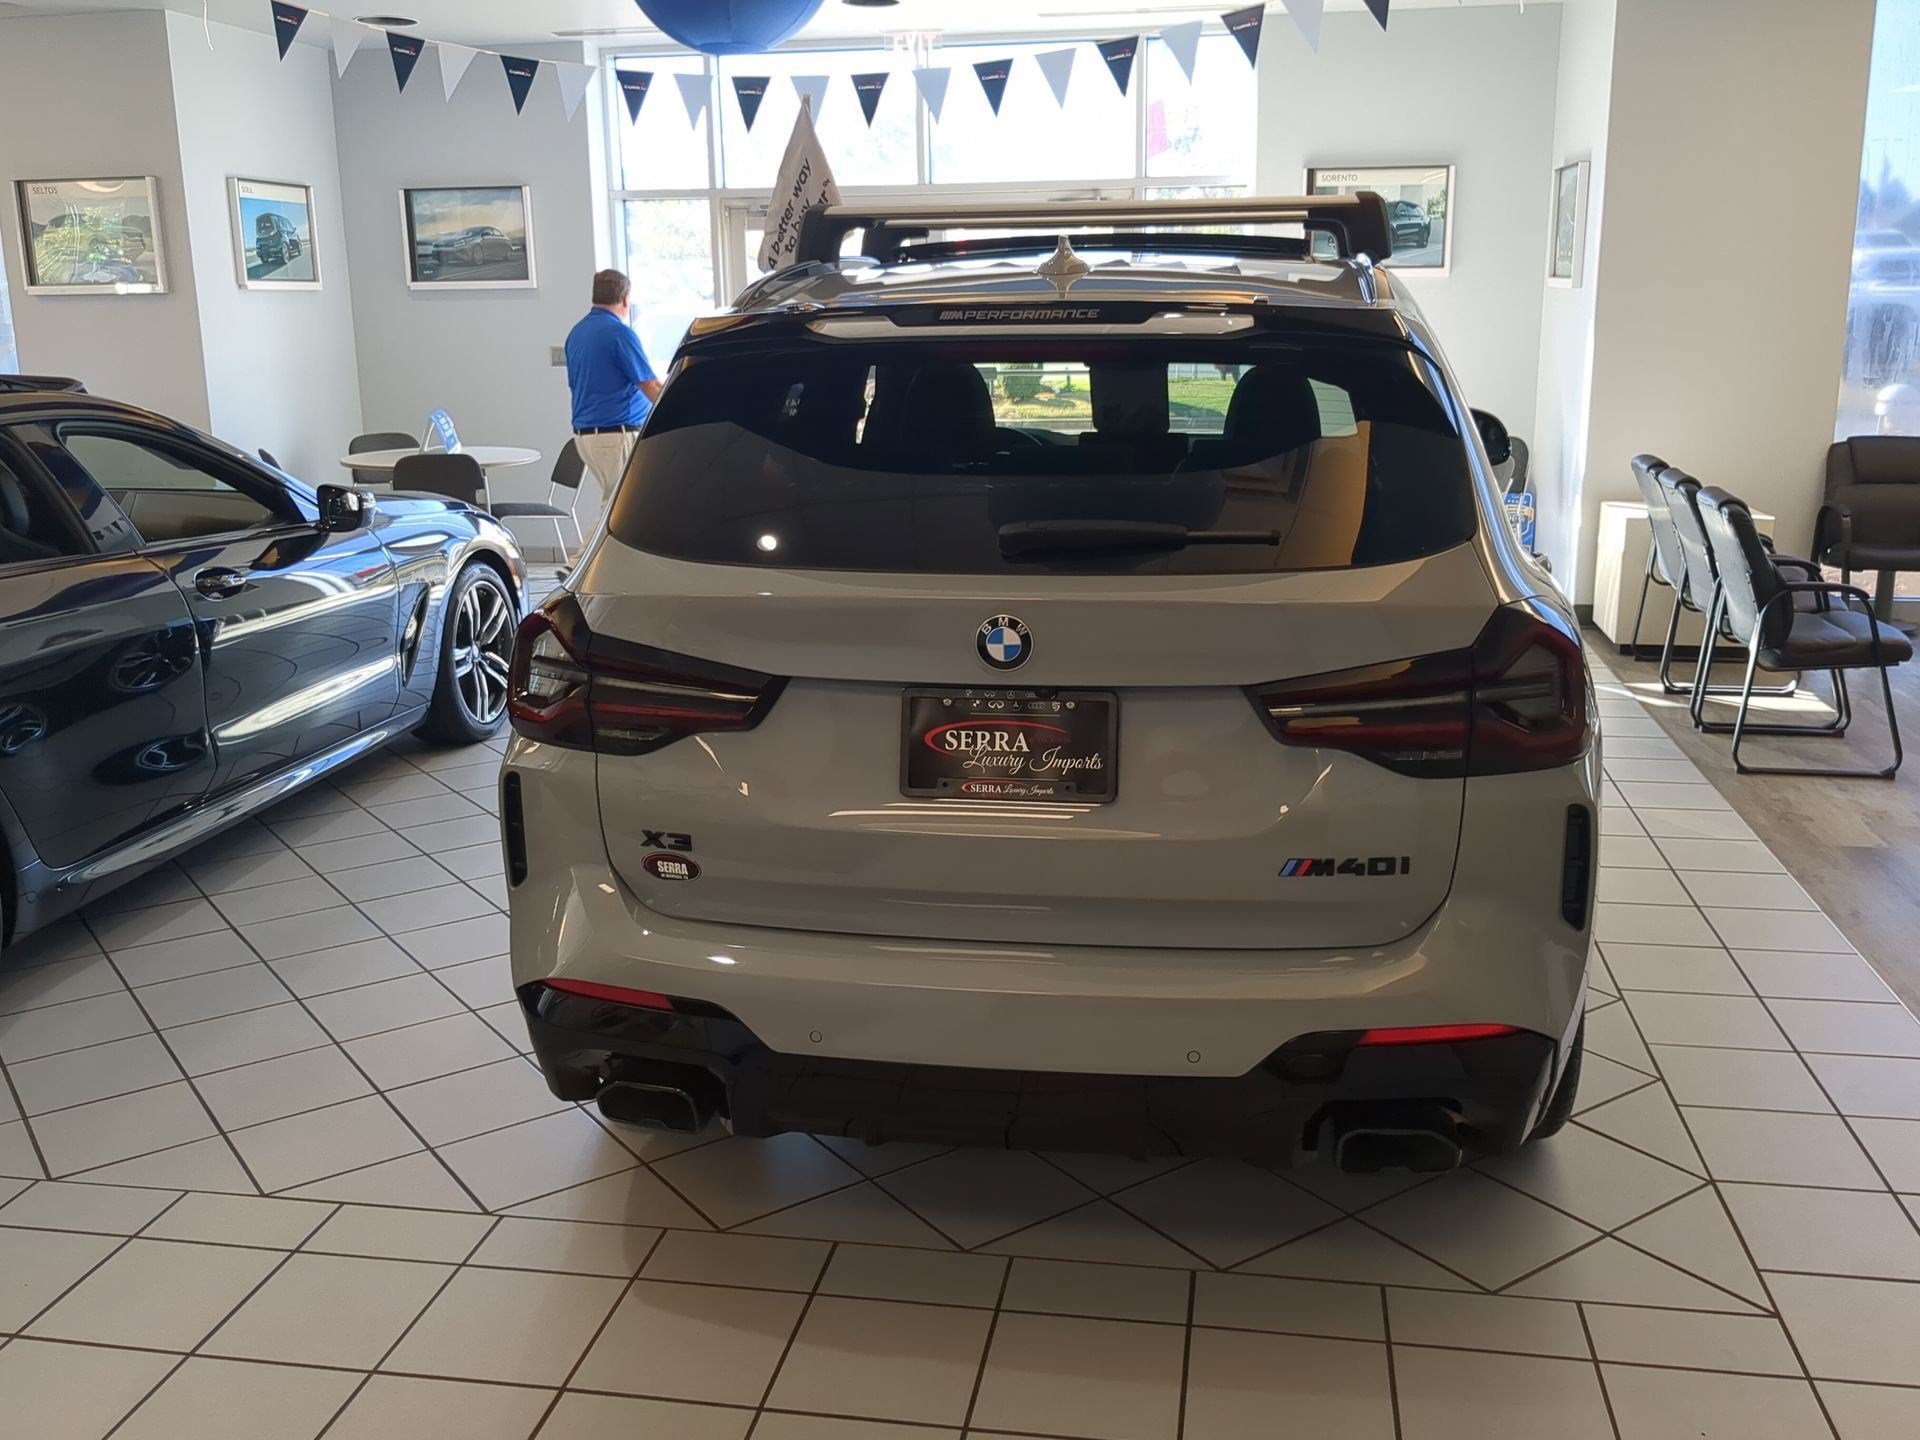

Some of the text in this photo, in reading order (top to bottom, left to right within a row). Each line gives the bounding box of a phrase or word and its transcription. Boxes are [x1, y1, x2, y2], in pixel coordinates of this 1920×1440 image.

[1321, 174, 1358, 182] SORENTO
[768, 157, 811, 270] A better way
[785, 235, 797, 254] to
[964, 308, 1100, 320] PERFORMANCE
[981, 617, 1028, 636] BMW
[945, 730, 1031, 752] SERRA
[963, 744, 1104, 775] Luxury Imports
[970, 784, 1002, 793] SERRA
[641, 830, 692, 851] X3
[657, 861, 689, 876] SERRA
